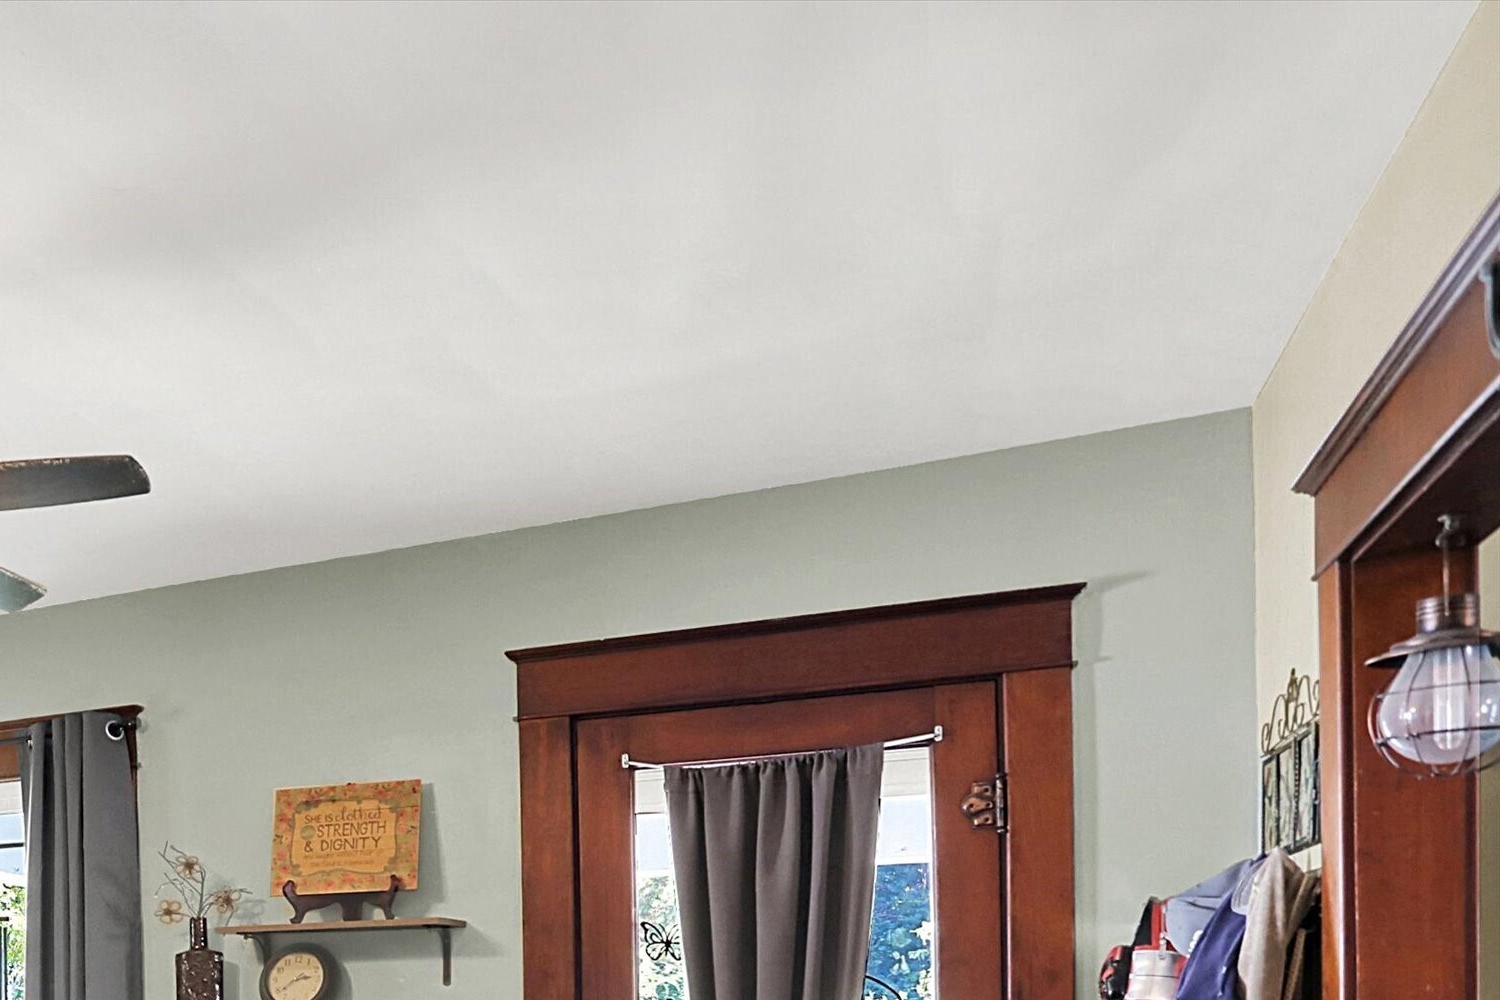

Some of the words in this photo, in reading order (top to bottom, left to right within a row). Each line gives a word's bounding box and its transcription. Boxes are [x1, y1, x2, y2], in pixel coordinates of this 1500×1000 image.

[304, 814, 321, 824] SHE
[325, 813, 334, 823] IS
[316, 821, 387, 838] STRENGTH
[304, 840, 314, 853] &
[320, 836, 382, 852] DIGNITY
